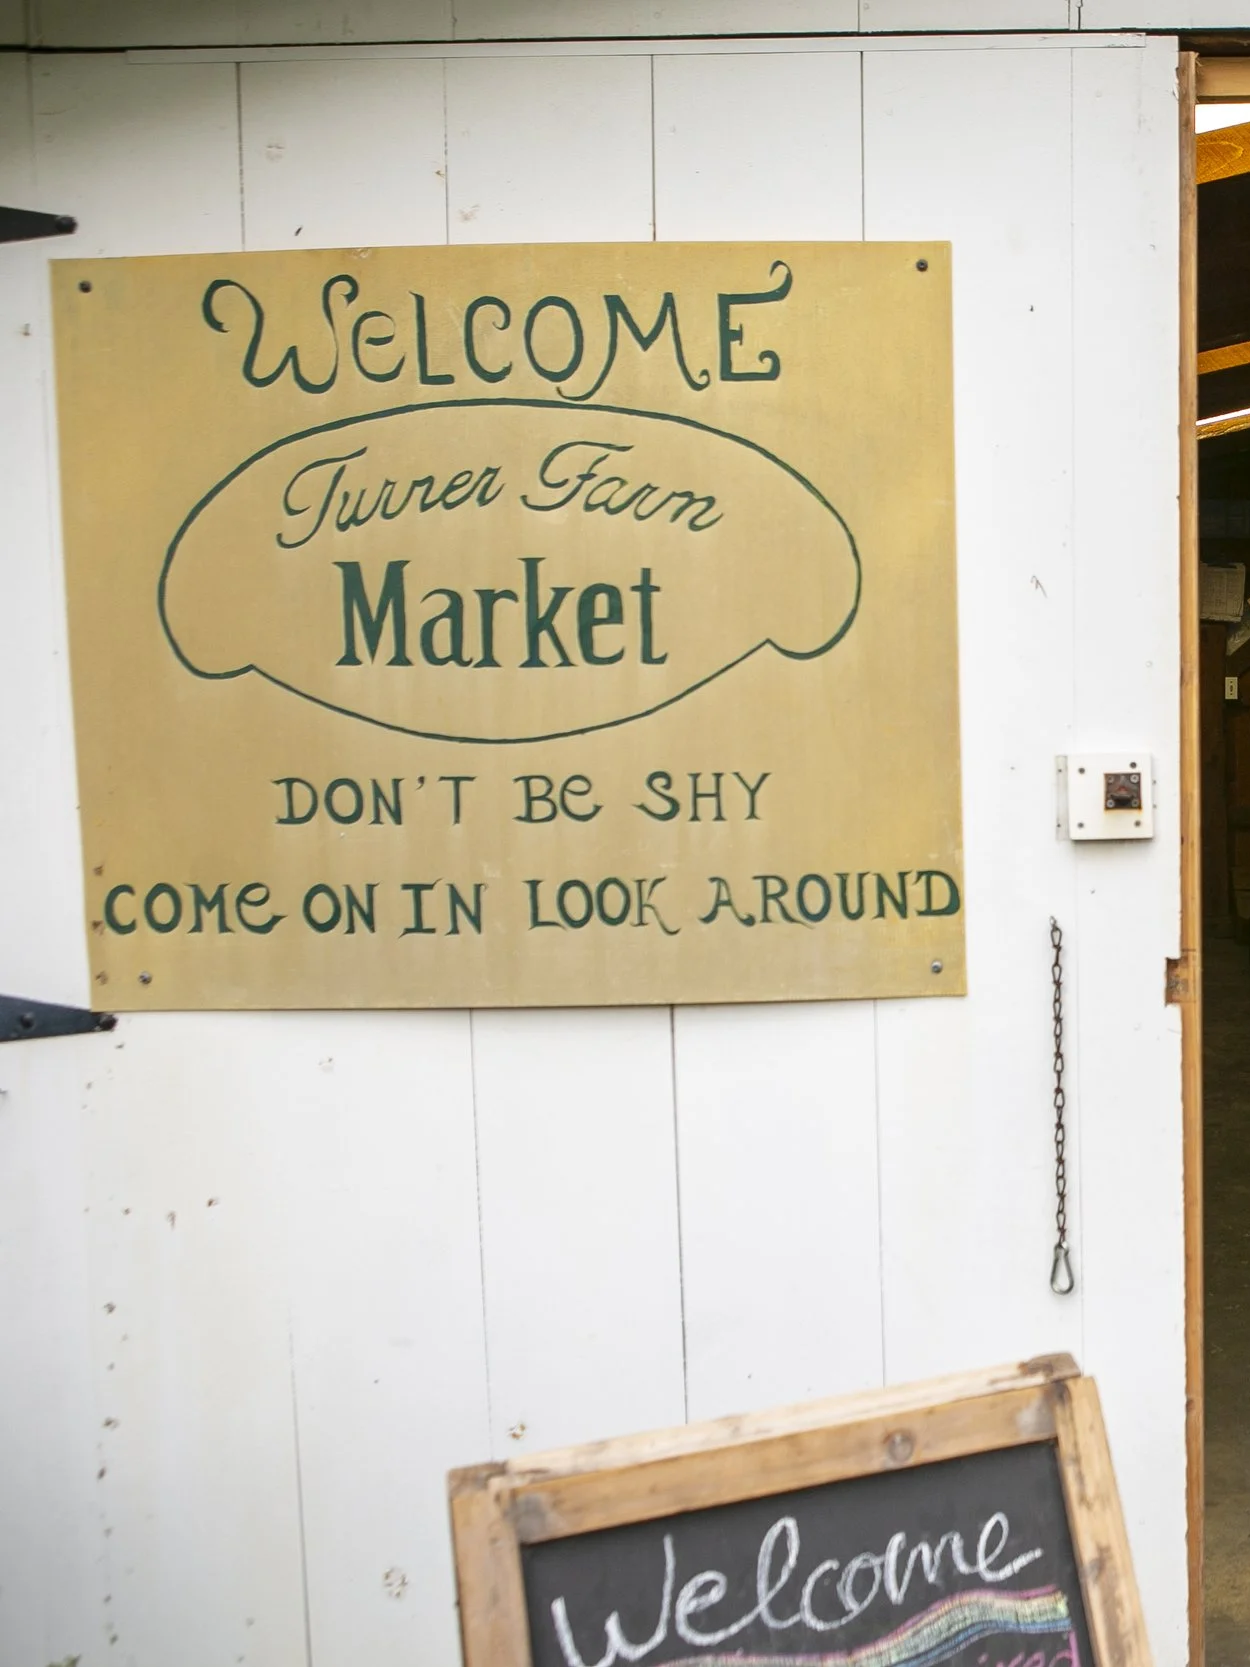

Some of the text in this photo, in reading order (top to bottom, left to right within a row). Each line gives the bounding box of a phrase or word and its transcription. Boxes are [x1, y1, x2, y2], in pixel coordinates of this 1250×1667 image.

[277, 440, 724, 548] Turner Farm
[334, 557, 668, 669] Market
[274, 774, 476, 826] DON'T
[635, 771, 772, 823] SHY
[302, 883, 379, 936] ON
[401, 881, 485, 936] IN
[528, 877, 680, 936] LOOK
[705, 870, 961, 927] AROUND
[550, 1510, 1045, 1667] Welcome
